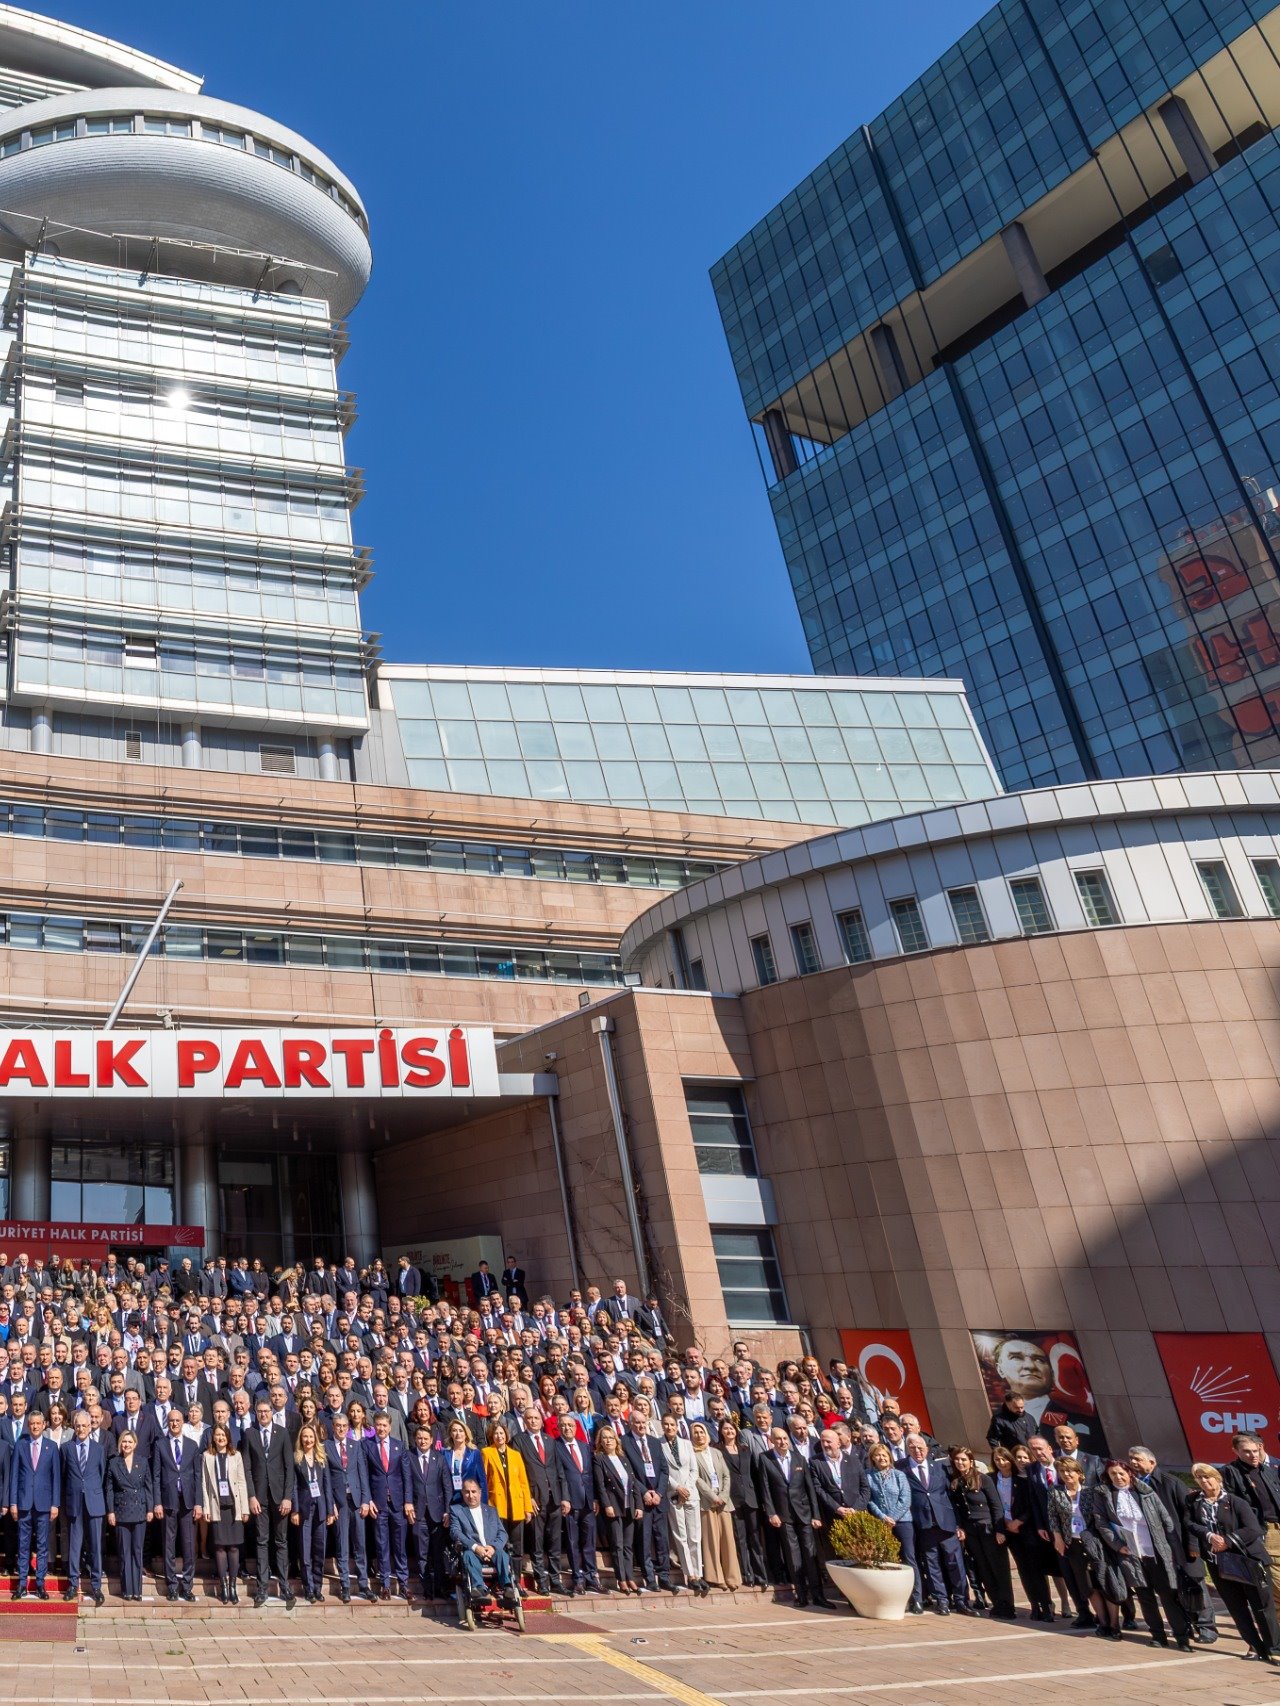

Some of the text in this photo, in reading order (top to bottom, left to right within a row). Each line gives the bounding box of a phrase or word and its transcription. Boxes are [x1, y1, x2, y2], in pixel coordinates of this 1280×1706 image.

[177, 1028, 470, 1088] PARTİSİ
[49, 1228, 87, 1240] HALK
[91, 1228, 144, 1242] PARTİSİ
[1200, 1411, 1269, 1434] CHP
